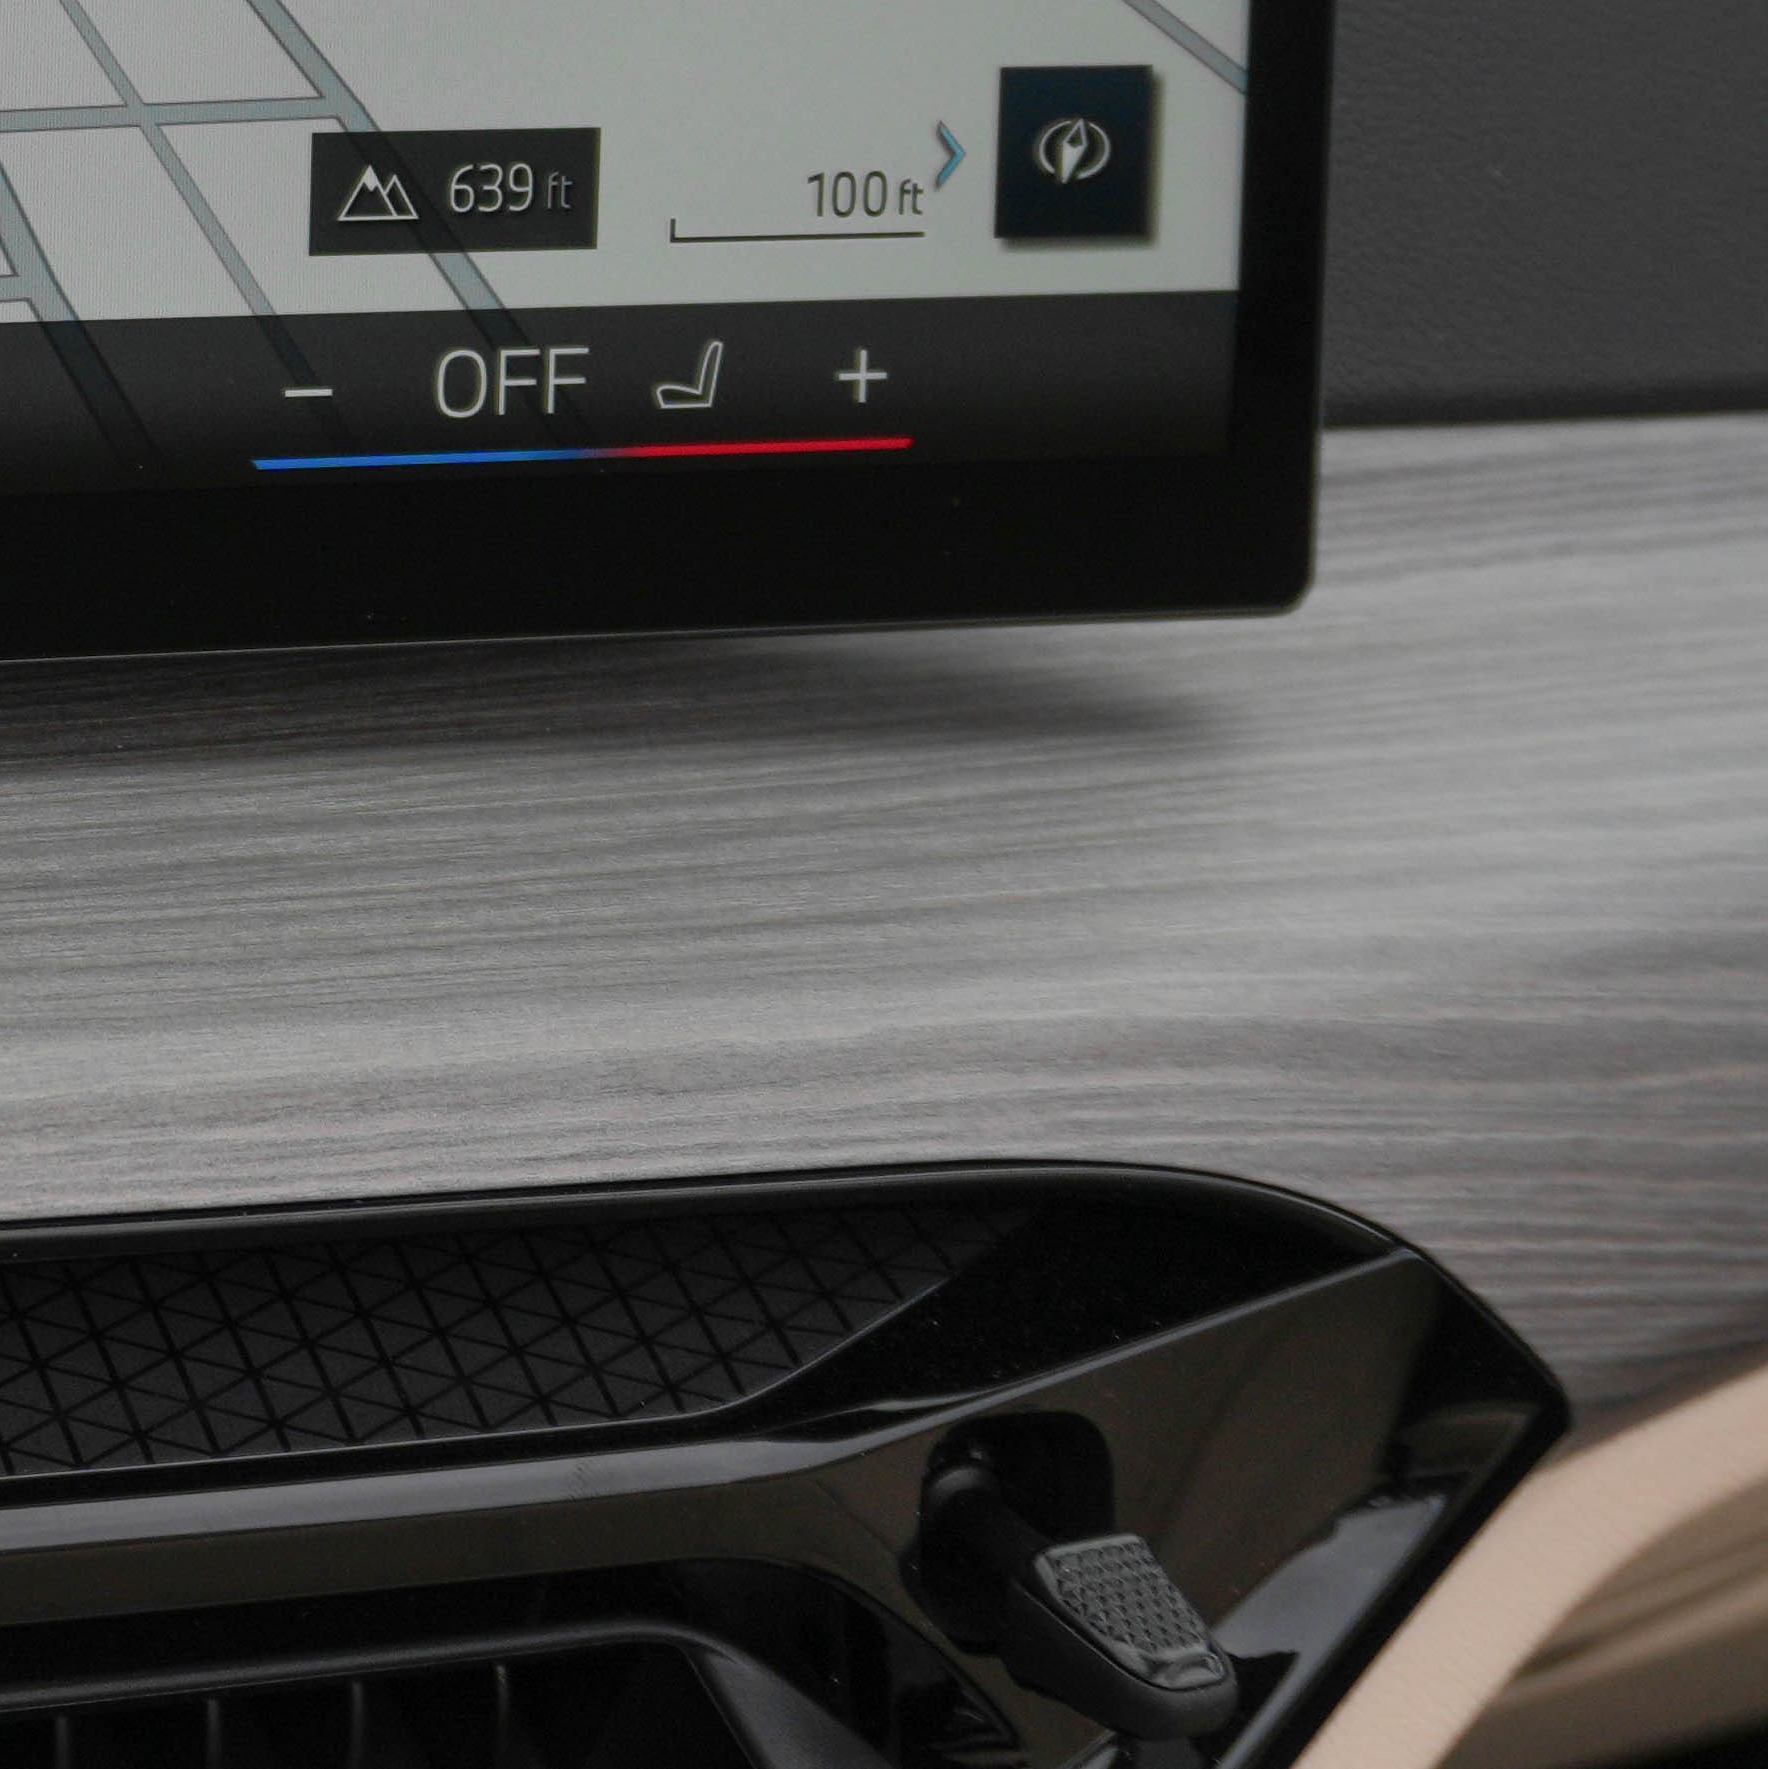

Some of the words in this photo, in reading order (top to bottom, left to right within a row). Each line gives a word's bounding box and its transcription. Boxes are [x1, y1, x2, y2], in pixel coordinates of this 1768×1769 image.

[450, 162, 533, 213] 639
[546, 171, 574, 210] ft
[807, 170, 888, 218] 100
[898, 178, 924, 215] ft
[437, 347, 590, 419] OFF
